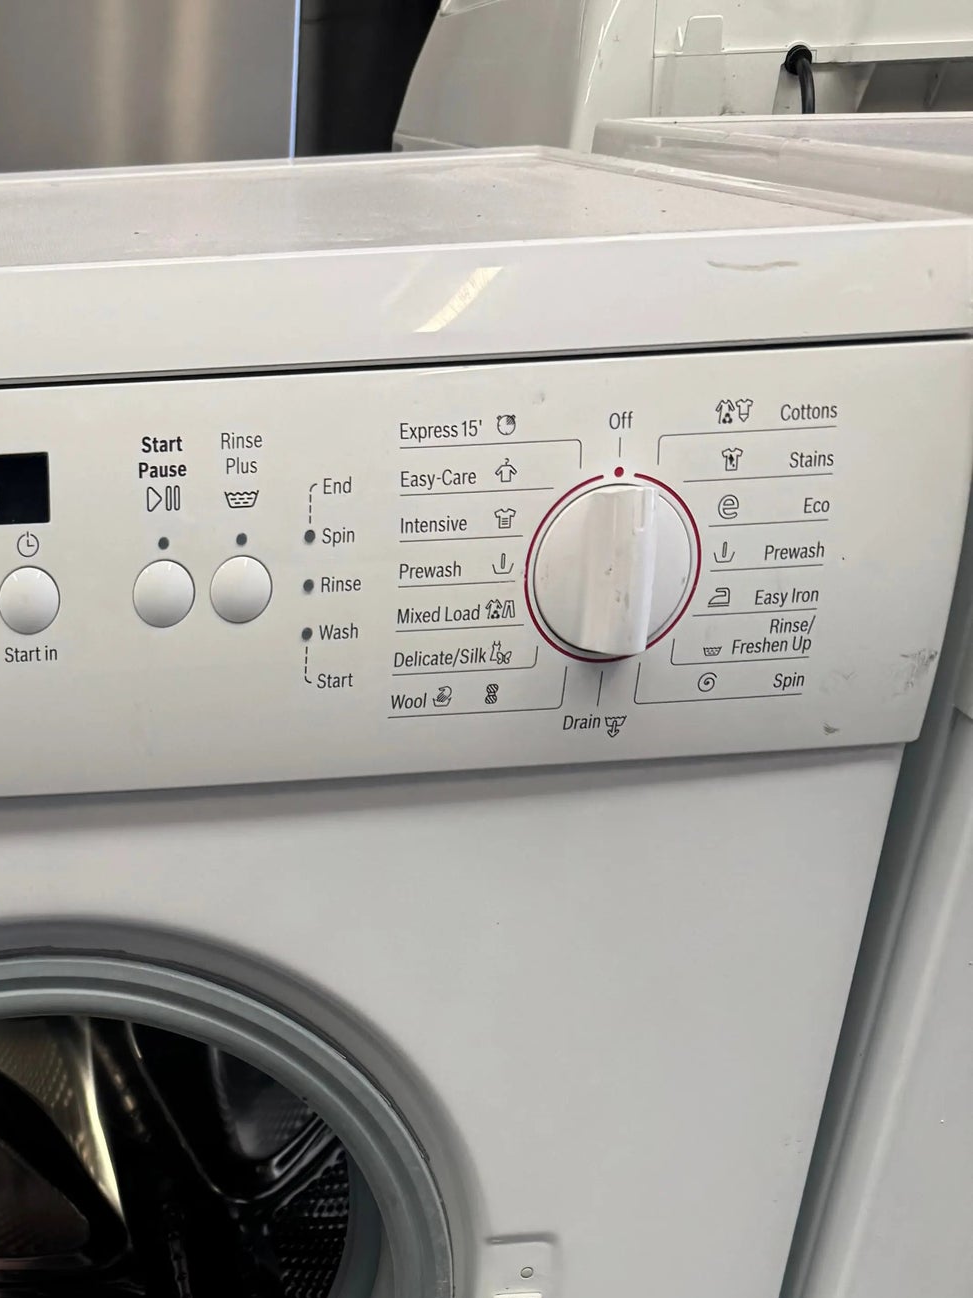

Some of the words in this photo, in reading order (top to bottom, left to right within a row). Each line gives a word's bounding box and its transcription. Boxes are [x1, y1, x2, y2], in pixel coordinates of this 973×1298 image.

[609, 411, 633, 430] Off
[780, 403, 838, 421] Cottons
[400, 422, 459, 443] Express
[462, 419, 482, 437] 15'
[141, 436, 184, 453] Start
[220, 432, 263, 450] Rinse
[226, 457, 258, 475] Plus
[789, 450, 834, 469] Stains
[138, 461, 187, 479] Pause
[400, 469, 477, 490] Easy-Care
[323, 476, 353, 496] End
[804, 497, 830, 514] Eco
[400, 515, 467, 534] Intensive
[322, 526, 355, 547] Spin
[764, 541, 825, 561] Prewash
[399, 561, 462, 579] Prewash
[321, 574, 362, 593] Rinse
[754, 589, 788, 608] Easy
[791, 587, 819, 603] Iron
[397, 606, 441, 624] Mixed
[445, 604, 480, 622] Load
[319, 622, 359, 640] Wash
[769, 615, 816, 635] Rinse/
[4, 646, 40, 664] Start
[44, 645, 58, 662] in
[731, 637, 788, 655] Freshen
[792, 636, 812, 654] Up
[394, 648, 487, 668] Delicate/Silk
[316, 670, 354, 689] Start
[773, 672, 805, 691] Spin
[391, 693, 427, 709] Wool
[563, 713, 601, 731] Drain
